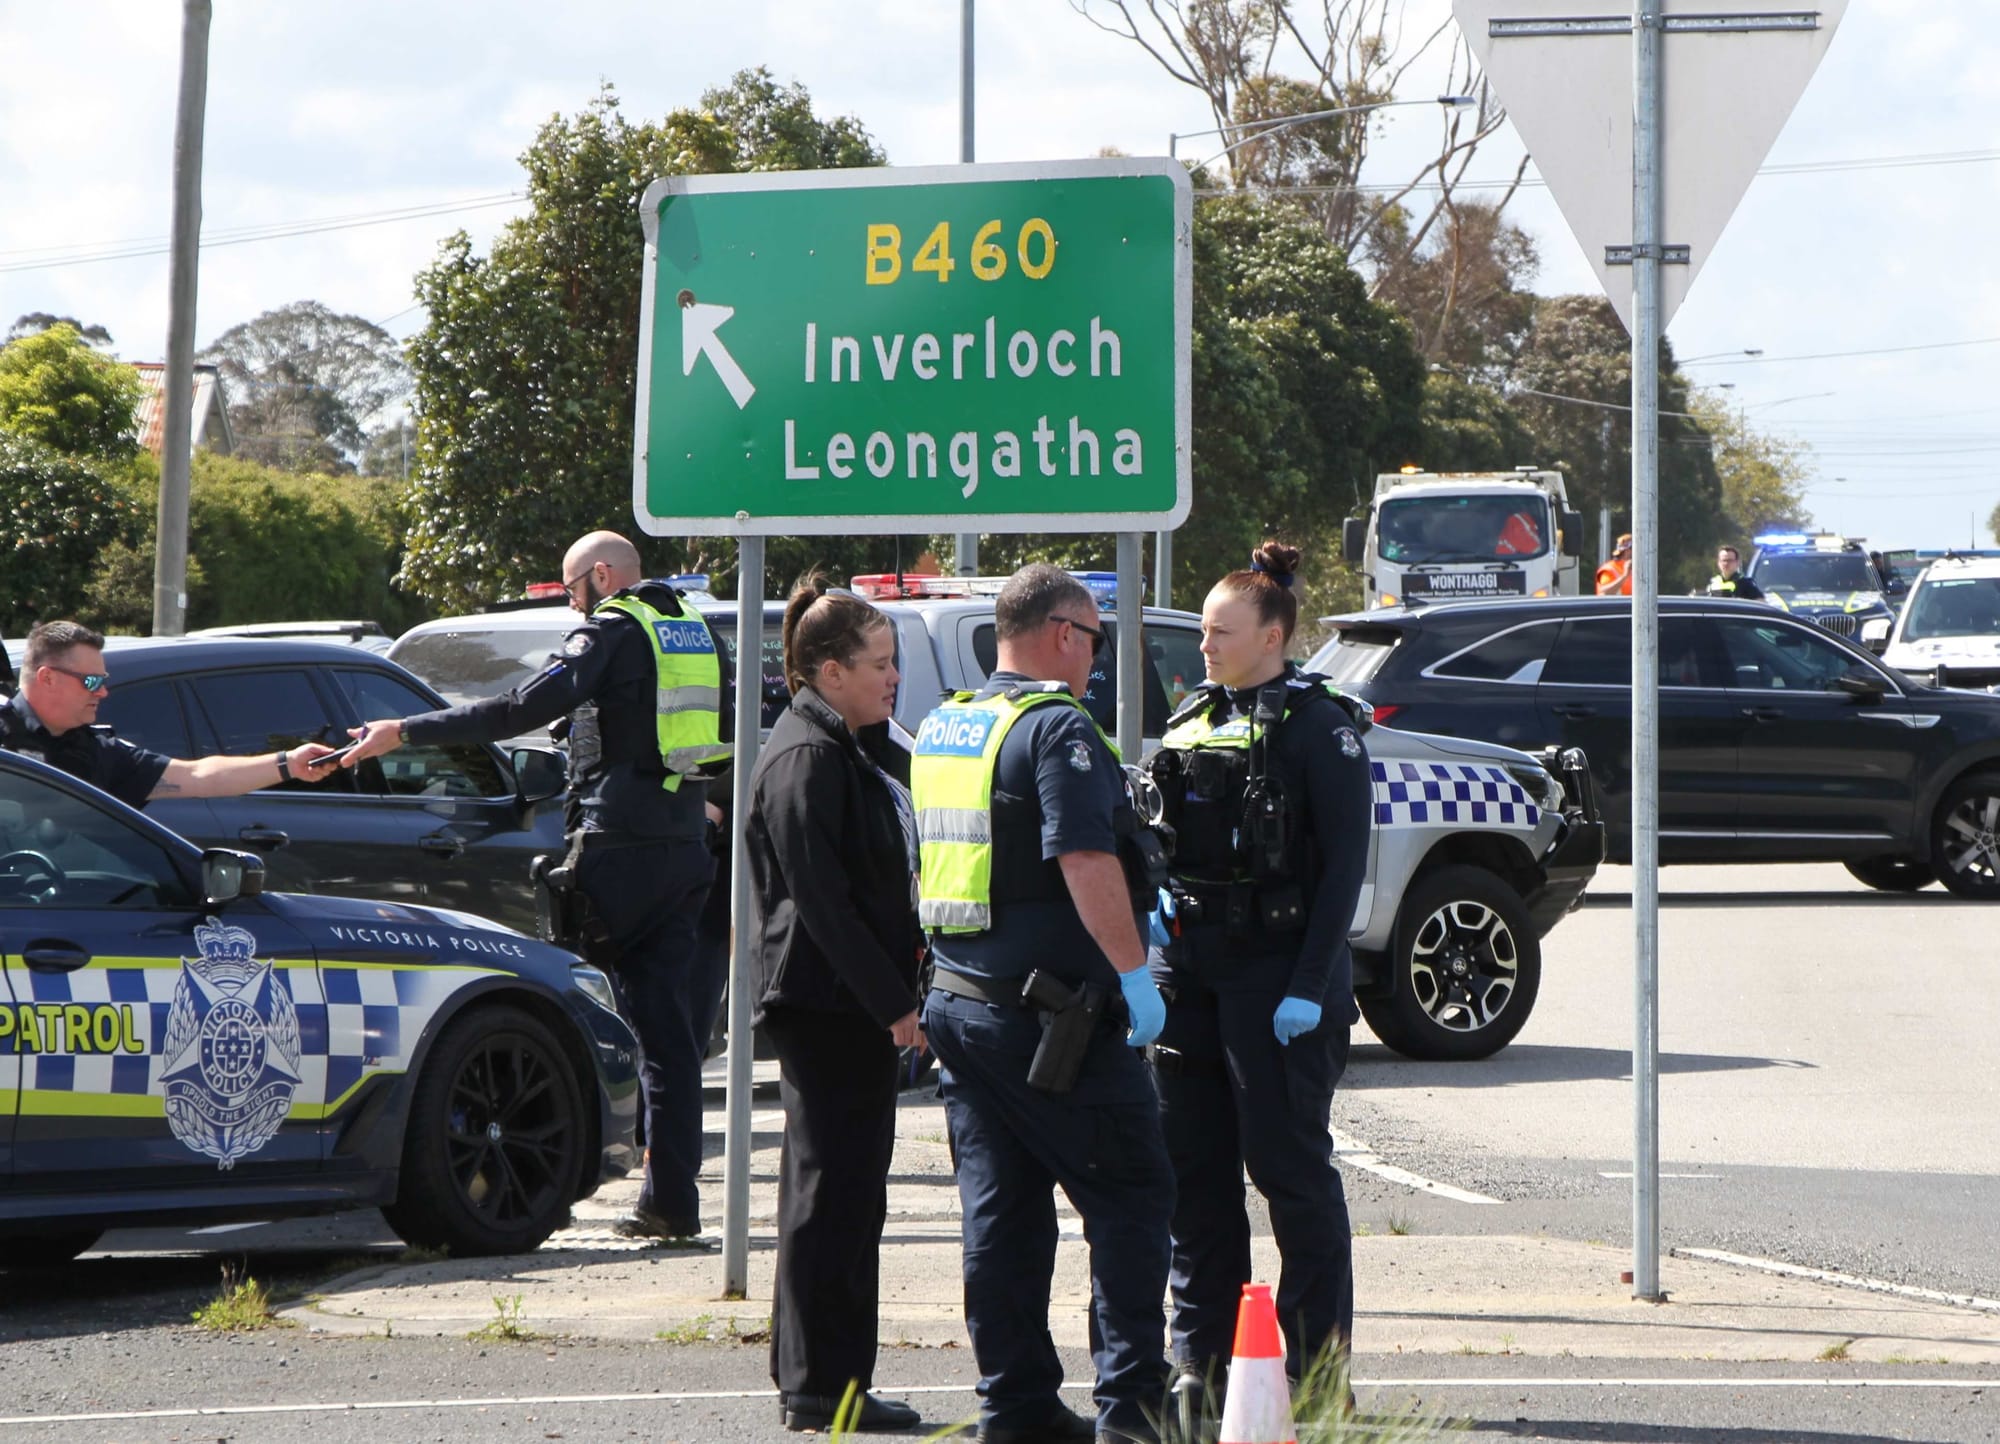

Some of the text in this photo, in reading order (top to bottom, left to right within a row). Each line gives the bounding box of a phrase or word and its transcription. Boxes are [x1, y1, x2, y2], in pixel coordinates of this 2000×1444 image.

[866, 217, 1057, 285] B460
[804, 315, 1122, 383] Inverloch
[784, 414, 1143, 499] Leongatha
[1429, 573, 1497, 590] WONTHAGGI
[657, 625, 712, 648] Police
[919, 715, 985, 748] Police
[330, 926, 525, 958] VICTORIA POLICE
[0, 1003, 144, 1054] PATROL
[202, 1003, 264, 1043] VICTORIA
[205, 1063, 260, 1093] POLICE
[182, 1084, 276, 1121] UPHOLD THE RIGHT
